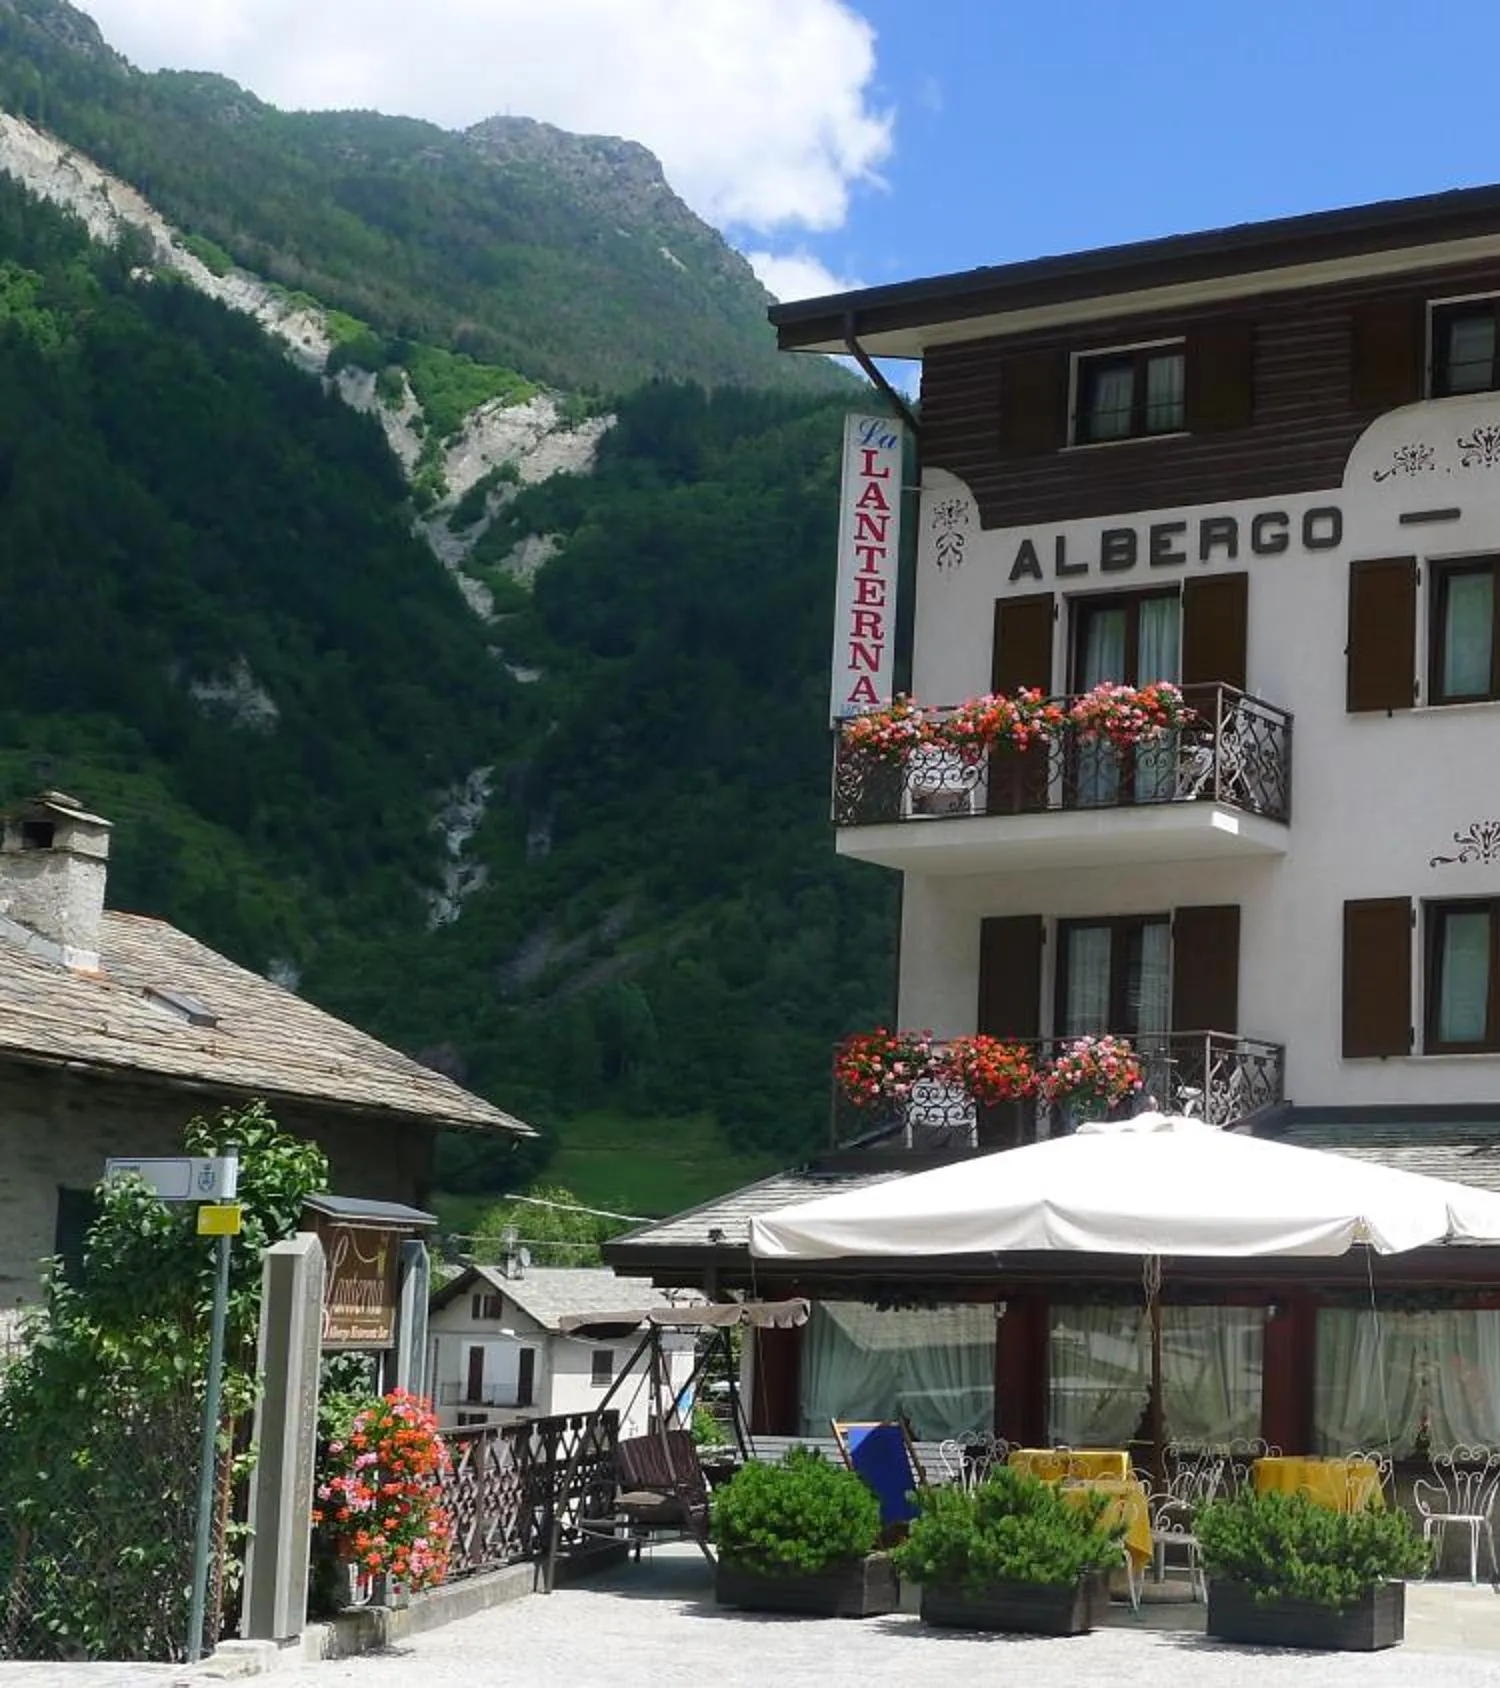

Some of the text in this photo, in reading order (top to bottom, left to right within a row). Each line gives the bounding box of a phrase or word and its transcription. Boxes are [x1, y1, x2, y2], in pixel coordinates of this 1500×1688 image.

[858, 419, 898, 449] La
[847, 448, 891, 705] LANTERNA
[1007, 505, 1343, 583] ALBERGO
